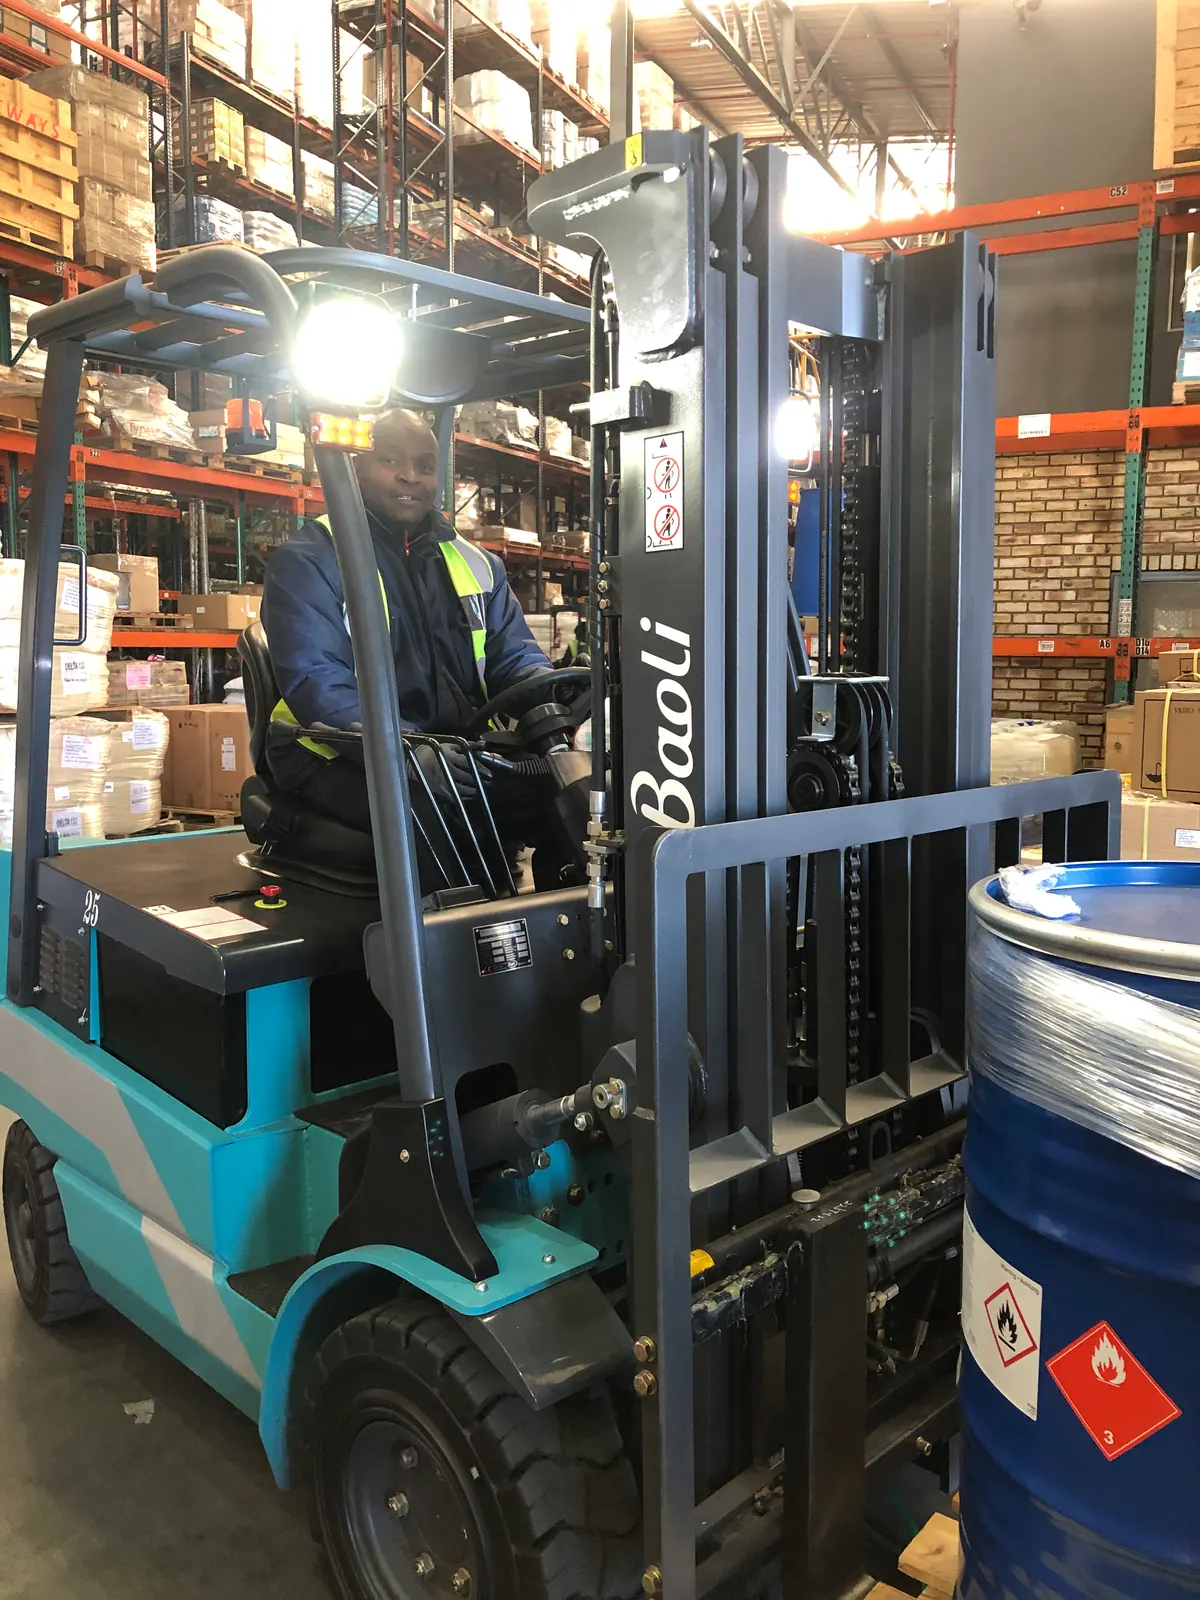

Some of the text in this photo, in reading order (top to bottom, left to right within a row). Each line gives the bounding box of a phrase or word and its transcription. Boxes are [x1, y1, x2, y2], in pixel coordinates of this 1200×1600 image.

[1100, 640, 1110, 649] A6
[630, 616, 696, 829] Baoli
[83, 889, 101, 927] 25
[1103, 1429, 1114, 1445] 3
